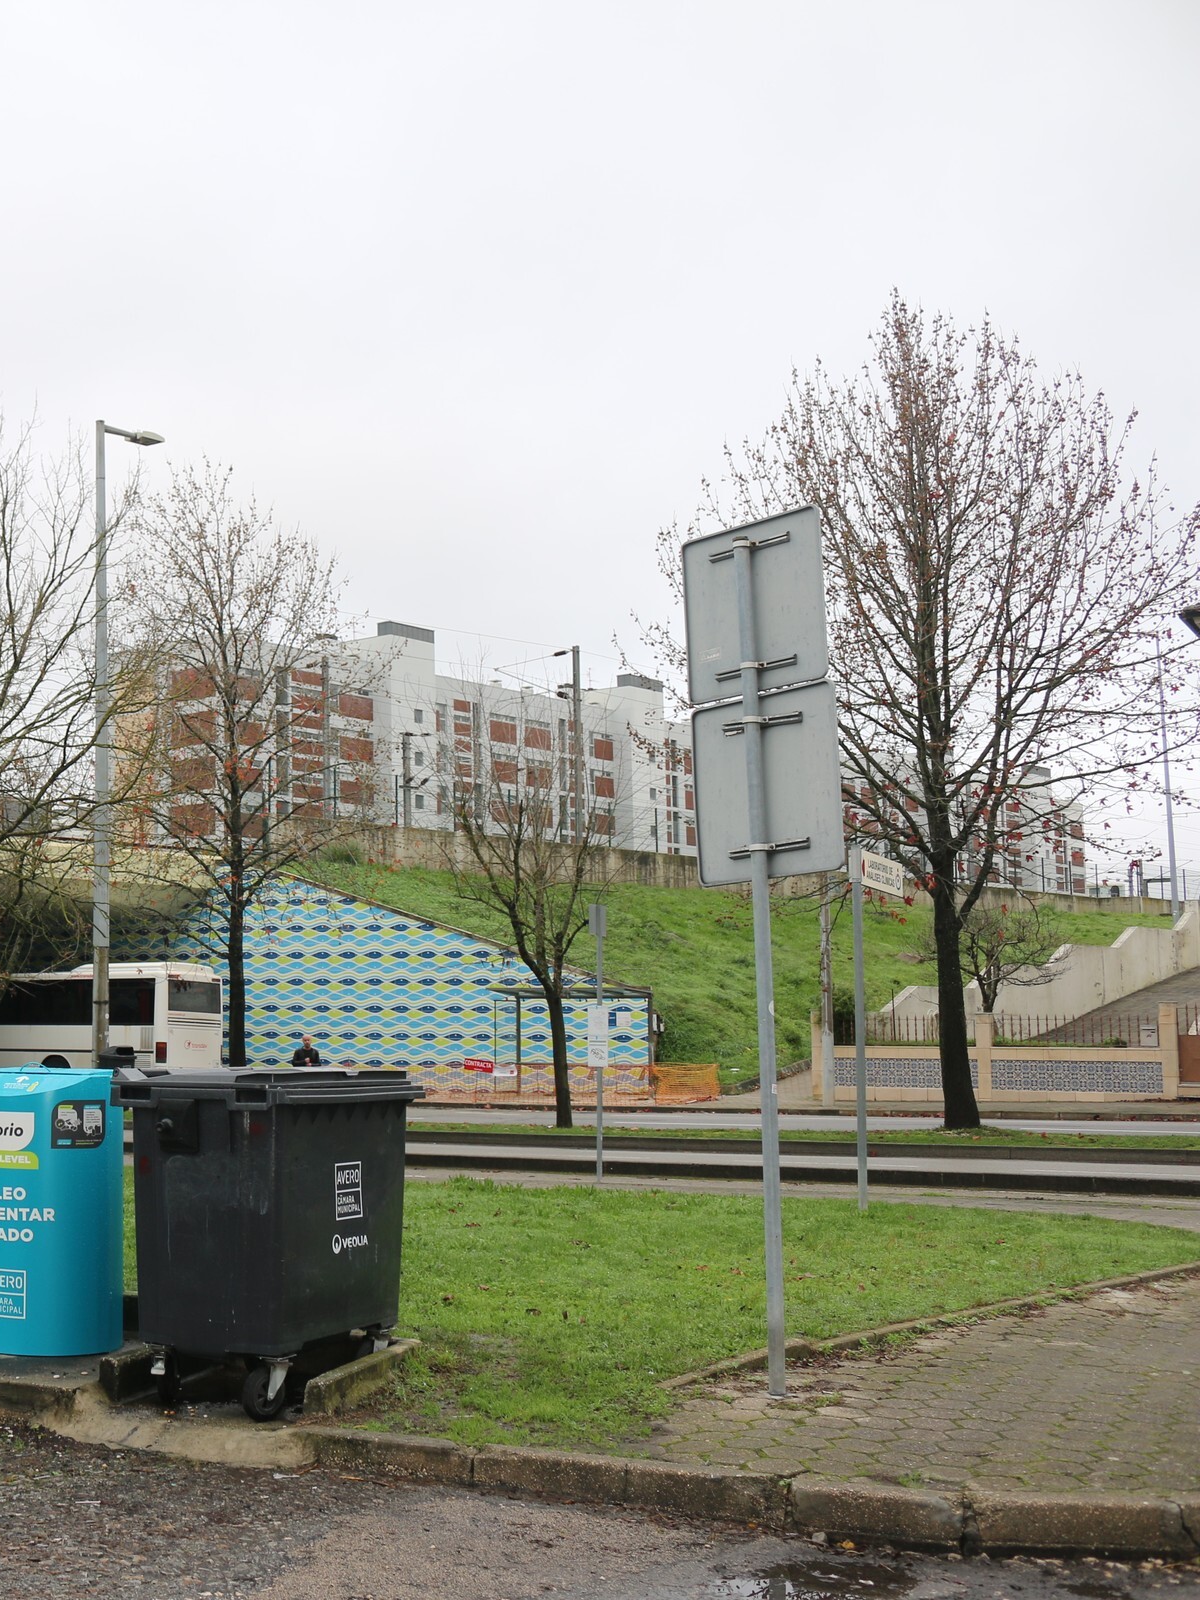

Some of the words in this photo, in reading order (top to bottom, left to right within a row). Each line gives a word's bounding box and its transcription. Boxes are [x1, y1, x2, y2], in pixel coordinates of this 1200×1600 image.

[0, 1154, 31, 1164] LEVEL
[337, 1204, 360, 1214] MUNICIPAL
[341, 1235, 368, 1248] VEOLIA
